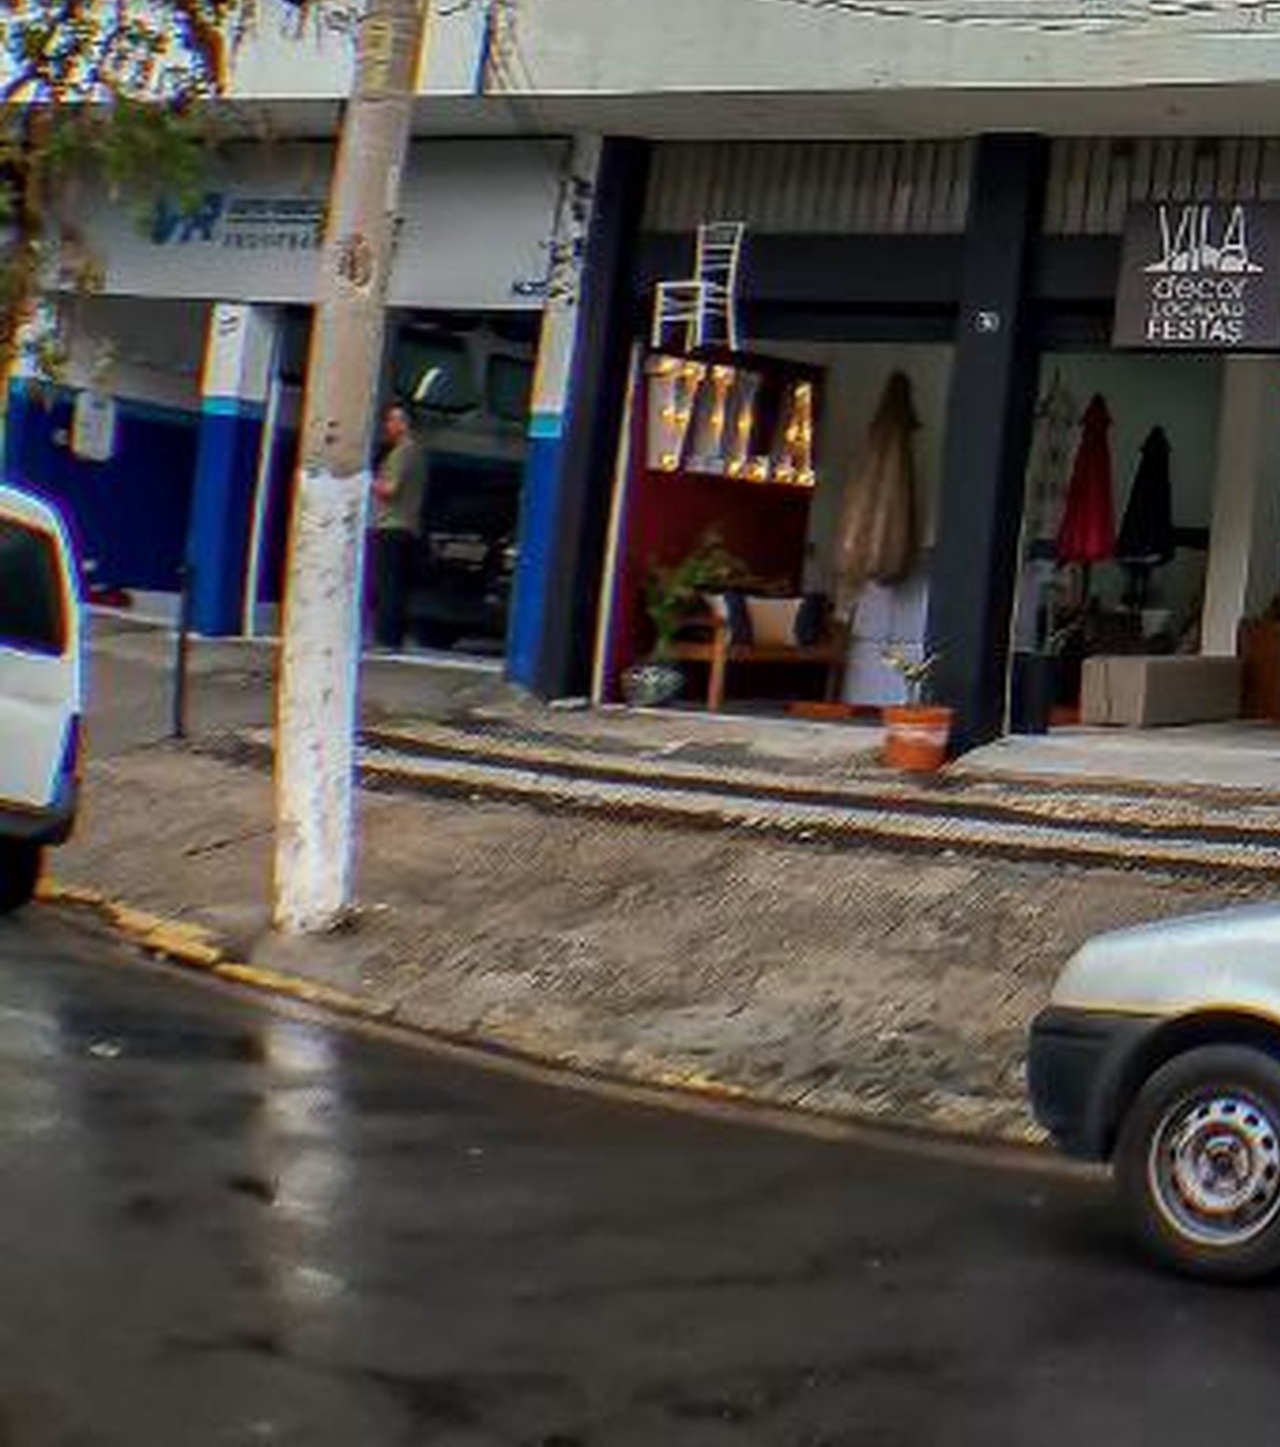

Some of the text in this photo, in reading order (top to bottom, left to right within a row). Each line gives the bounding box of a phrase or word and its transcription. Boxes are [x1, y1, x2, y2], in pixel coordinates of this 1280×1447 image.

[1145, 205, 1262, 272] VILA
[1152, 275, 1248, 299] decor
[1147, 319, 1244, 345] FESTAS
